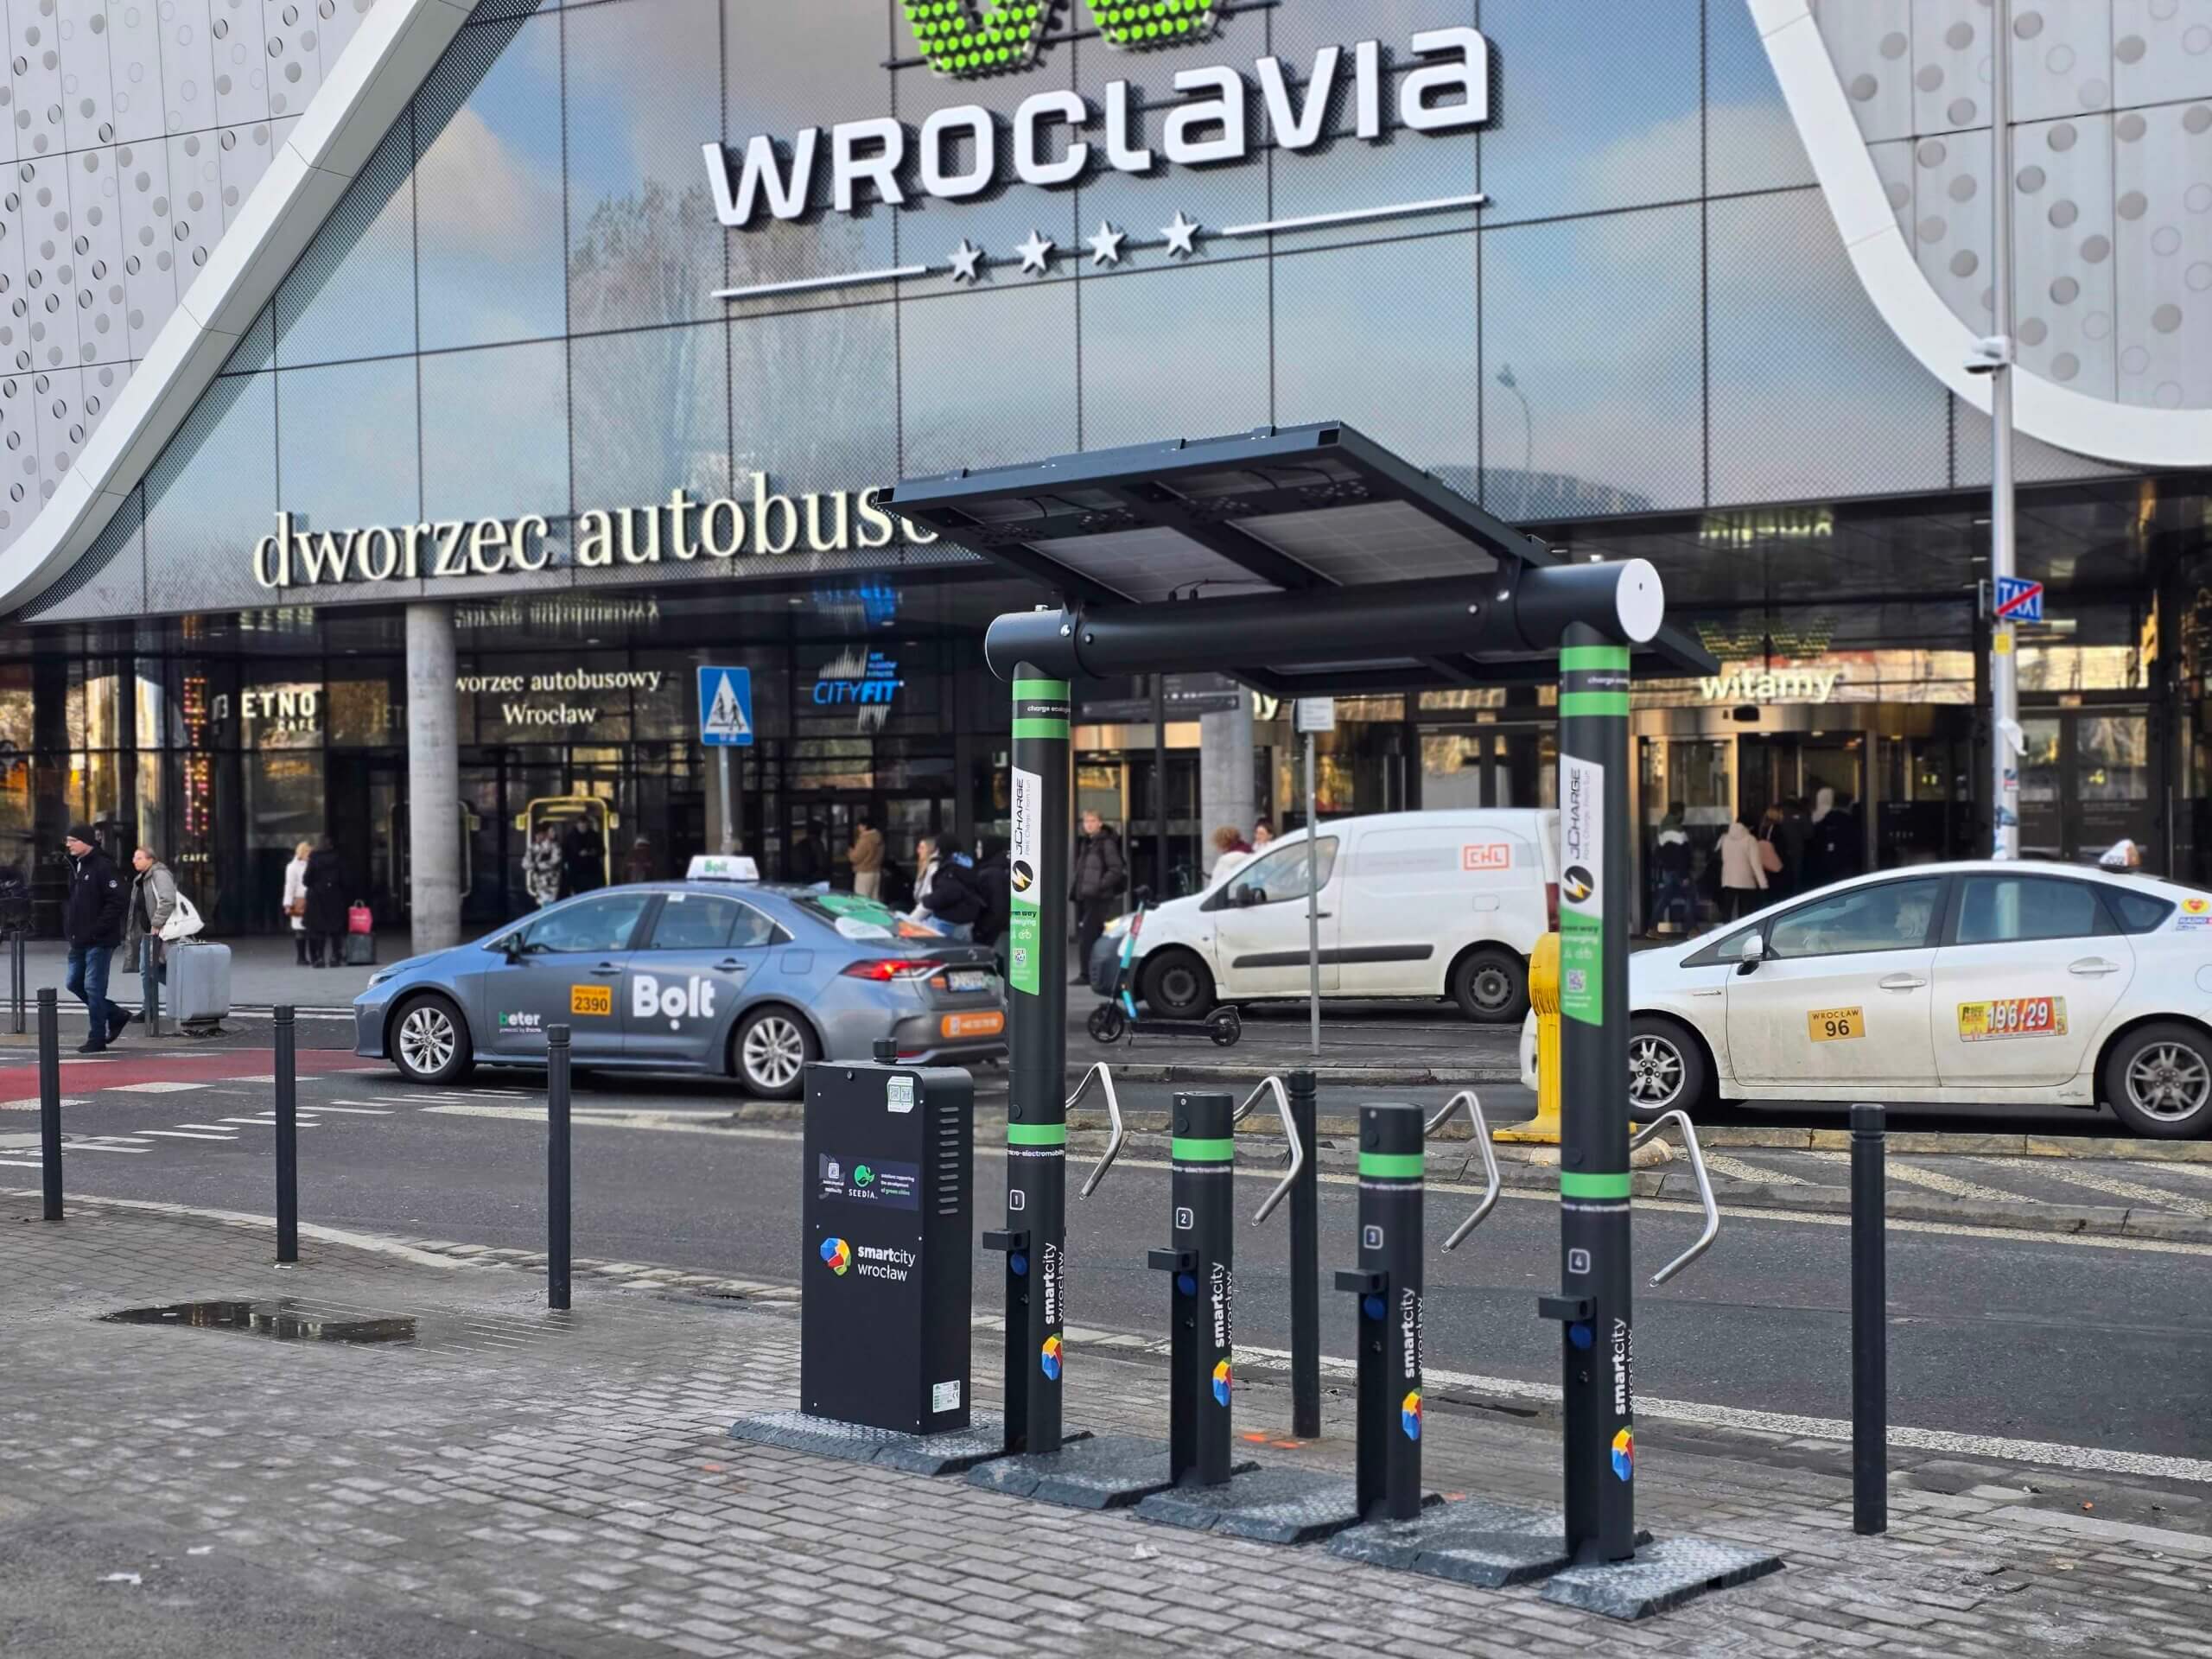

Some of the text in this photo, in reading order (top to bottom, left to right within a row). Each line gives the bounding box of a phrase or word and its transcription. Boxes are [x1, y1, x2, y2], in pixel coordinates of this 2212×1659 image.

[253, 512, 550, 588] dworzec
[2000, 582, 2042, 617] TAXI
[531, 668, 662, 692] autobusowy
[813, 680, 899, 704] CITYFIT
[1699, 667, 1837, 703] witamy
[241, 692, 316, 718] ETNO
[502, 702, 597, 725] Wrocław
[575, 996, 608, 1012] 2390
[632, 975, 716, 1030] Bolt
[499, 1011, 541, 1026] beter
[1825, 1020, 1850, 1037] 96
[858, 1245, 916, 1268] smartcity
[858, 1263, 907, 1281] wrocław
[1042, 1243, 1057, 1325] smartcity
[1210, 1262, 1224, 1348] smartcity
[1400, 1287, 1415, 1378] smartcity
[1611, 1317, 1627, 1415] smartcity
